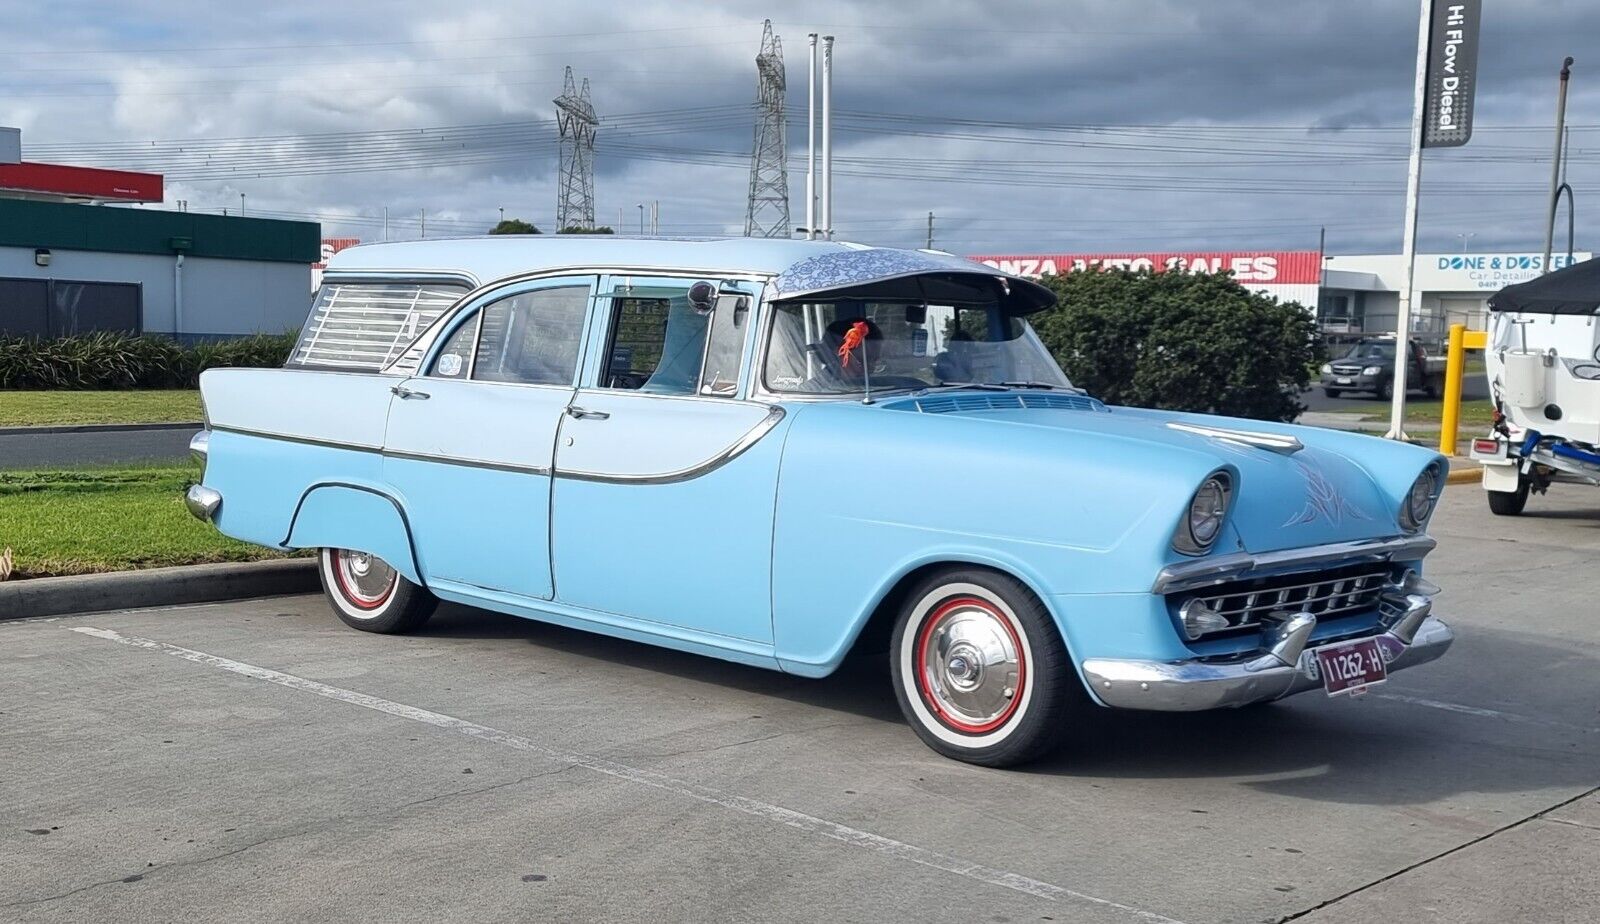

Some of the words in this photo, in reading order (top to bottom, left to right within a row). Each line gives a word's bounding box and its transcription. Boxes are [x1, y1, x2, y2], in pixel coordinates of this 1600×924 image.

[1446, 5, 1465, 26] Hi
[1444, 29, 1464, 74] Flow
[1439, 76, 1459, 131] Diesel
[1437, 256, 1486, 270] DONE
[1490, 256, 1503, 270] &
[1506, 255, 1577, 270] DUSED
[1468, 271, 1489, 280] Car
[1493, 271, 1546, 280] Detailin
